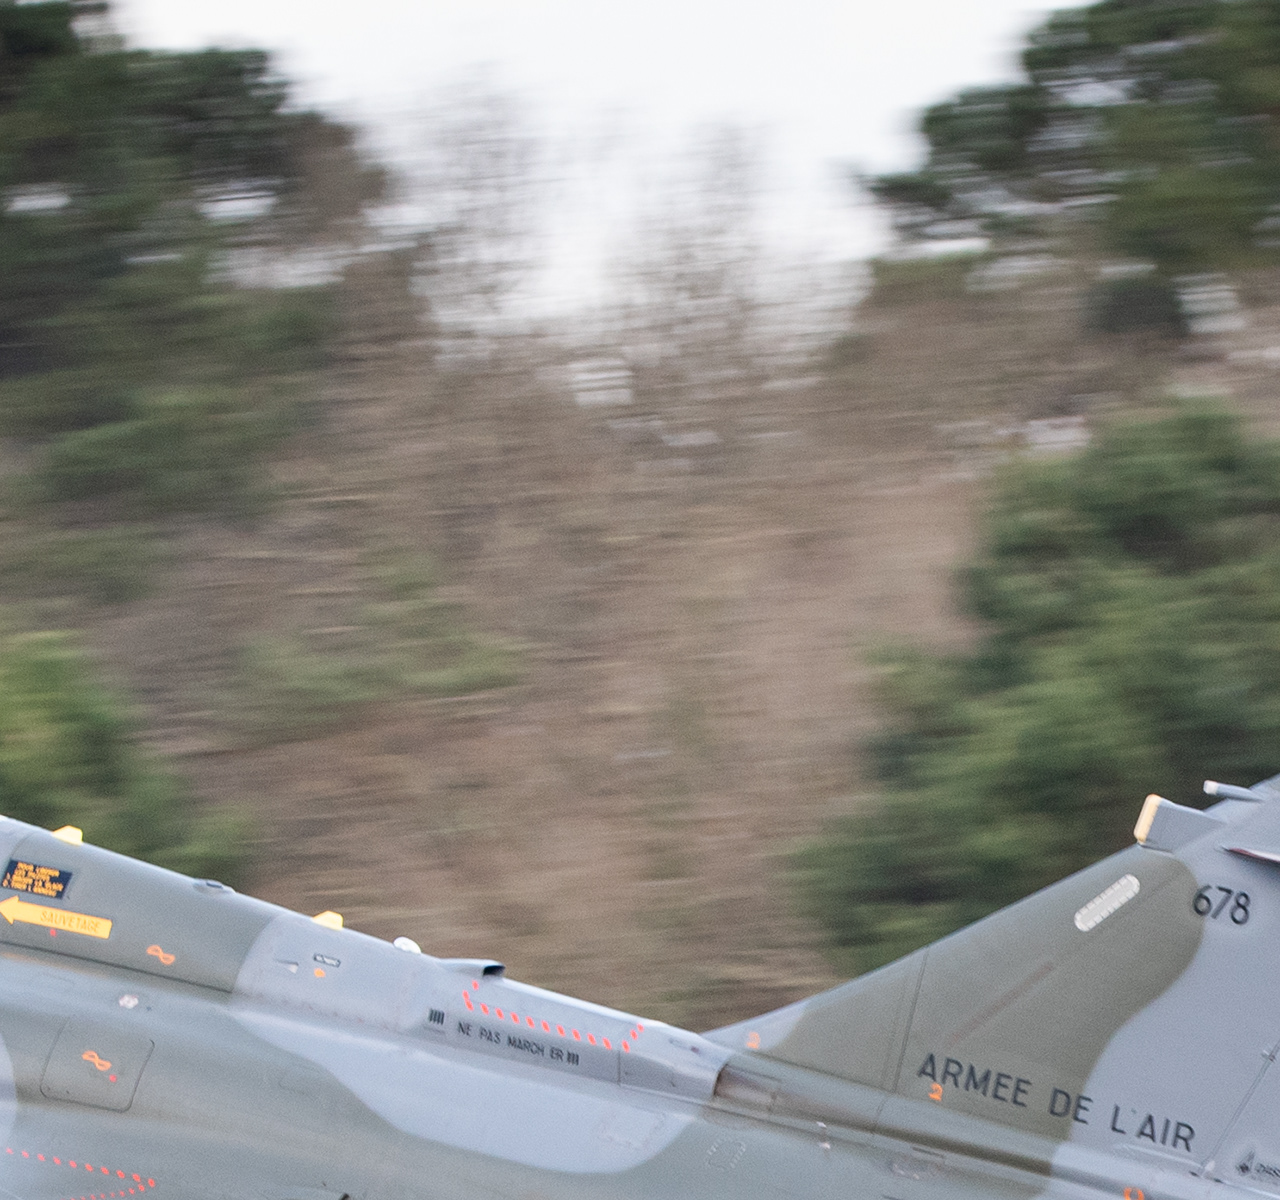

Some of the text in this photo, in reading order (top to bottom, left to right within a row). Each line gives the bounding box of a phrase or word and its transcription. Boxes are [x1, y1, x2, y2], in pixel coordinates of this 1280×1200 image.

[1192, 885, 1251, 925] 678
[40, 910, 101, 932] SAUVETAGE
[458, 1021, 472, 1037] NE
[479, 1027, 501, 1044] PAS
[918, 1053, 1032, 1107] ARMEE
[1048, 1087, 1093, 1125] DE
